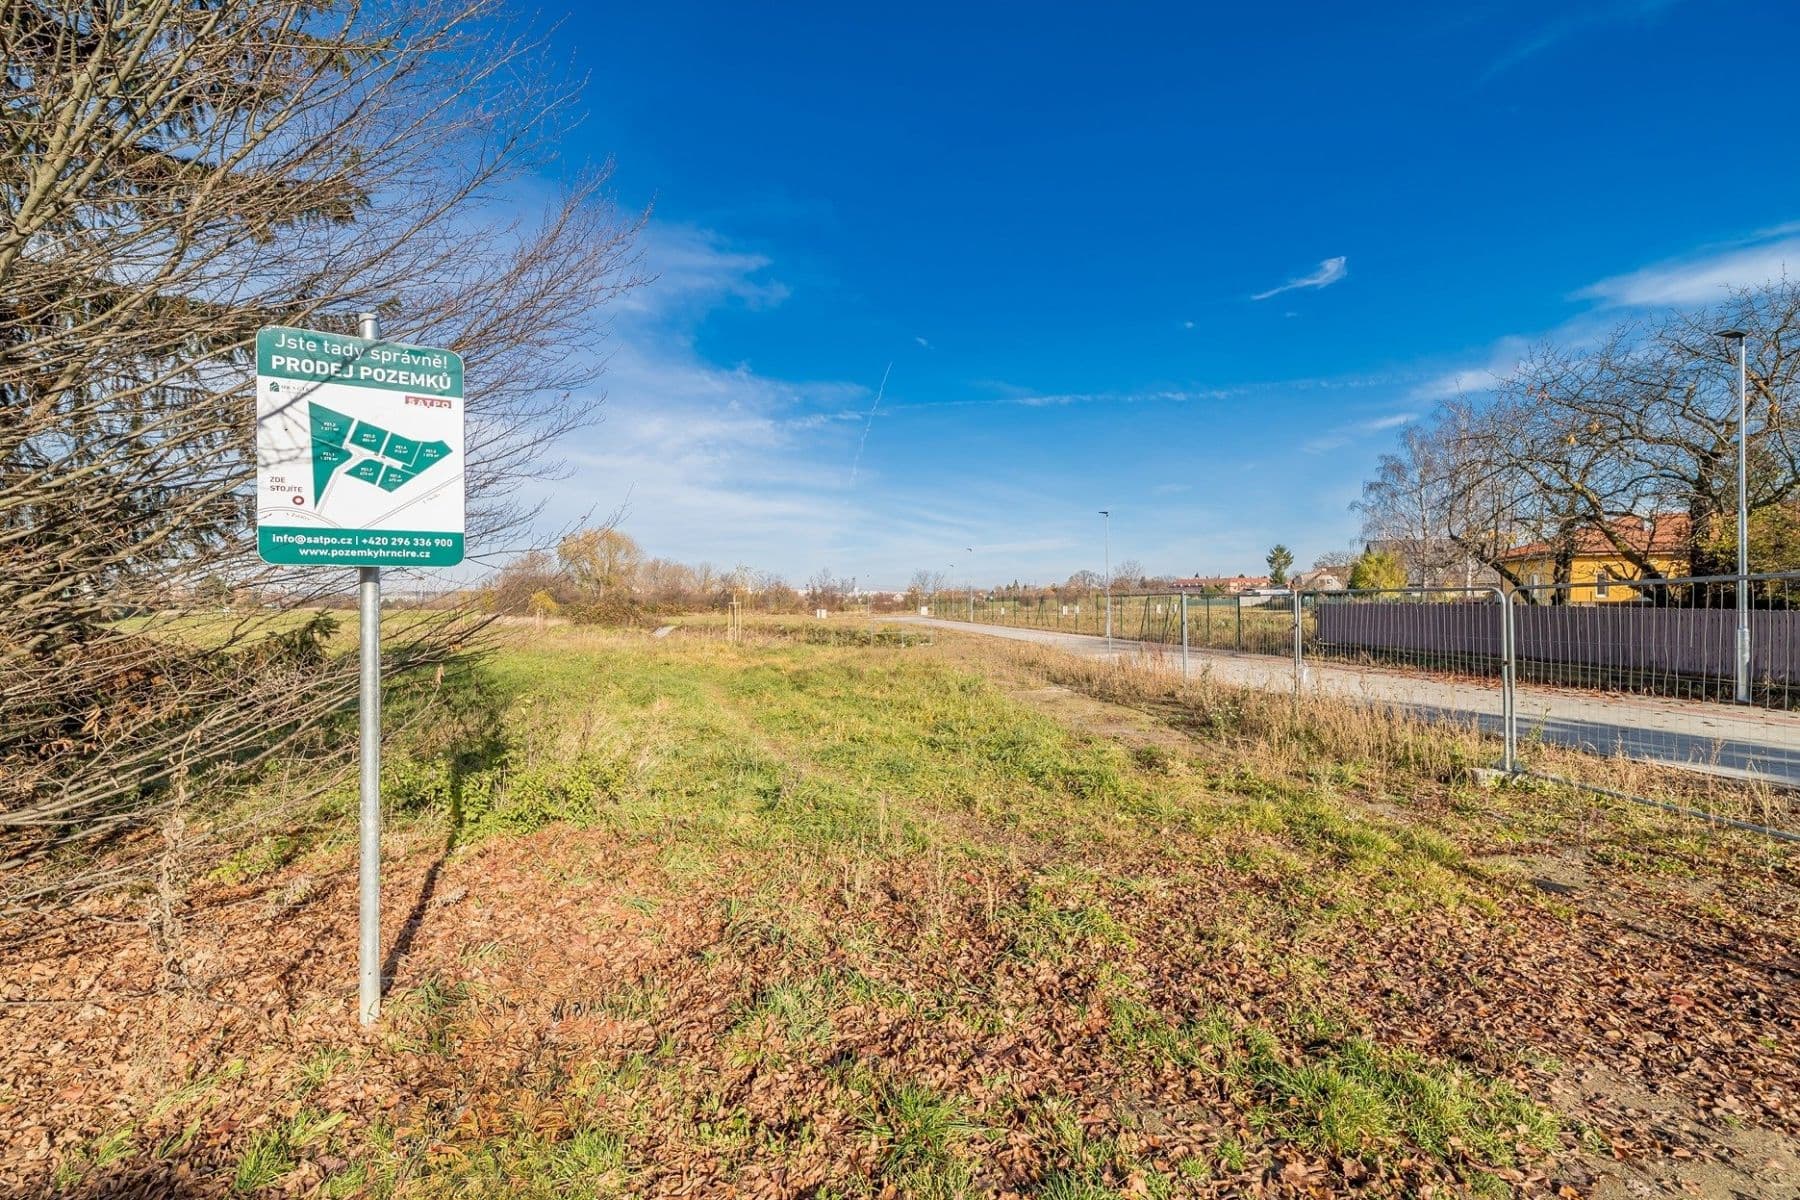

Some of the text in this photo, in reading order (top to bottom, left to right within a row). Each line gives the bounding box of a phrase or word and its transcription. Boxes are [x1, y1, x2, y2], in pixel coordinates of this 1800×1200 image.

[275, 333, 448, 369] Jste tady správně!
[271, 355, 450, 389] PRODEJ POZEMKŮ
[408, 397, 449, 408] SATPO
[272, 534, 352, 545] info@satpo.cz
[362, 537, 388, 545] +420
[391, 537, 410, 546] 296
[413, 538, 432, 546] 336
[434, 538, 453, 547] 900
[299, 548, 431, 558] www.pozemkyhrncire.cz
